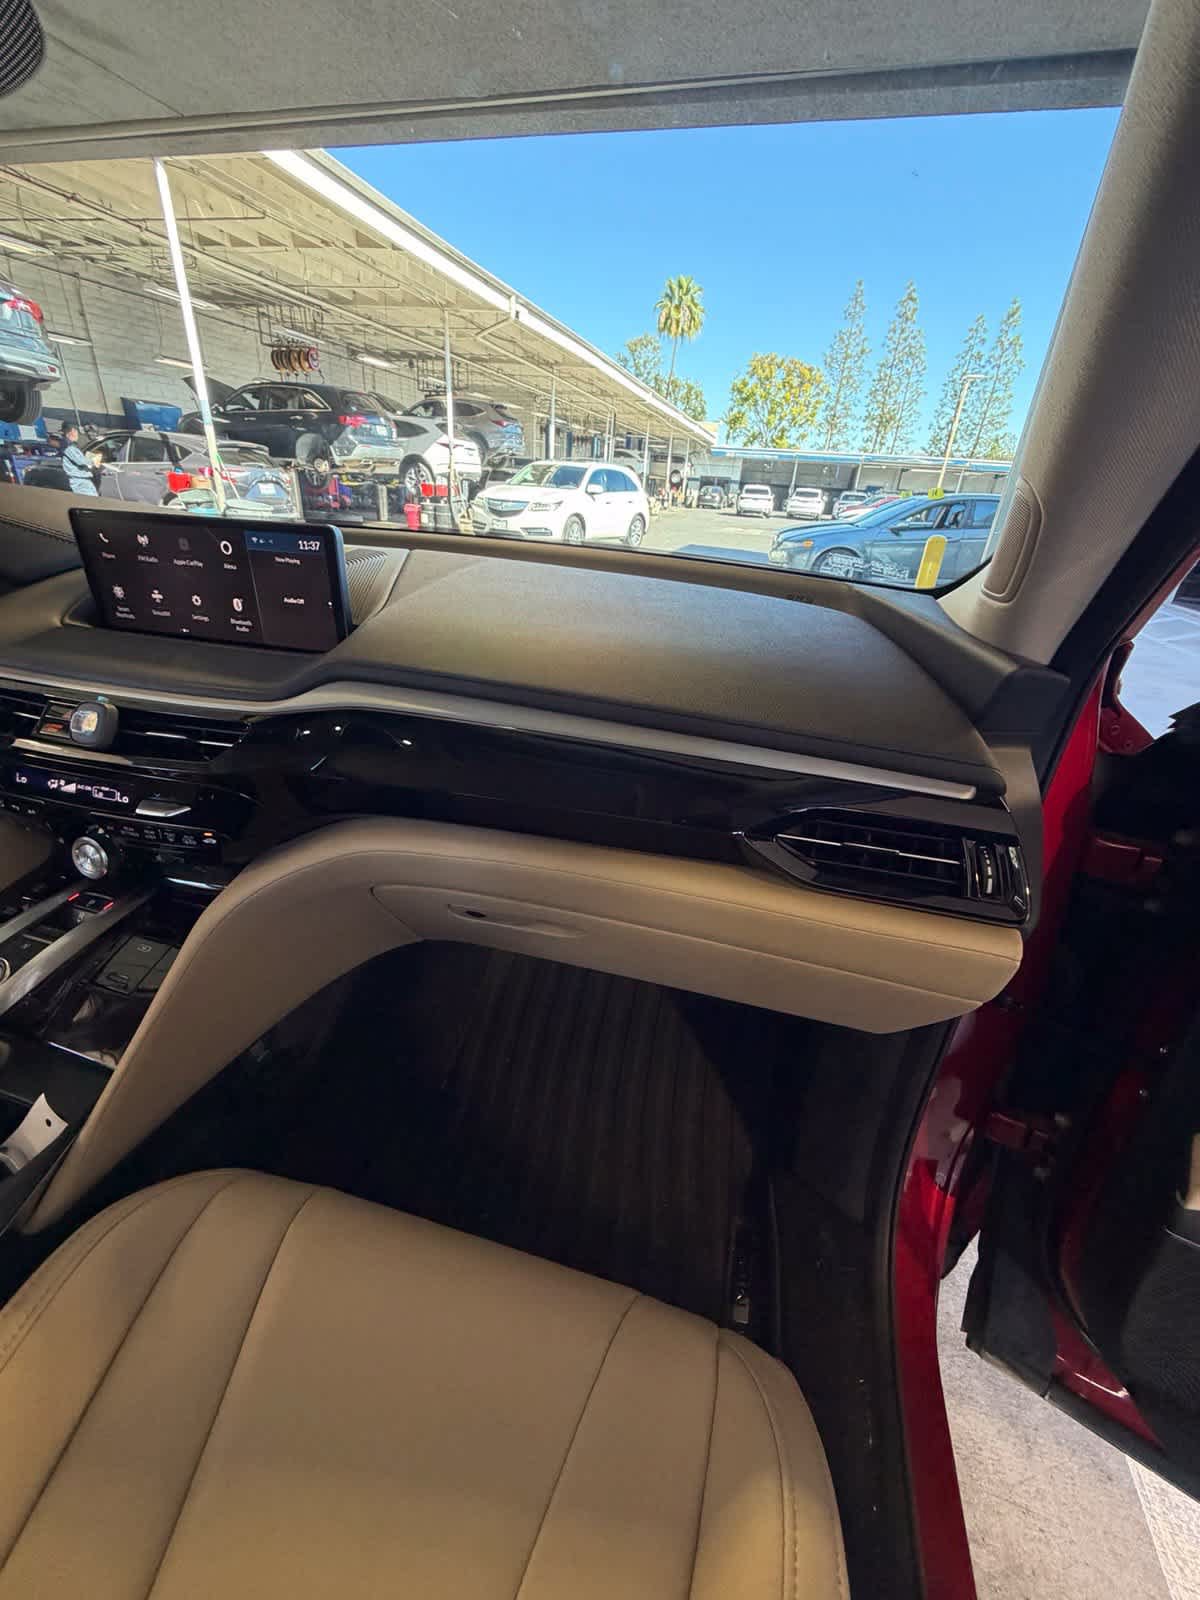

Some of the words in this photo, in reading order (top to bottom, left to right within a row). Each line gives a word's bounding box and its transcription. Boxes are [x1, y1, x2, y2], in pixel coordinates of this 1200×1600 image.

[298, 540, 321, 551] 11:37
[15, 771, 28, 784] Lo
[116, 791, 129, 804] Lo
